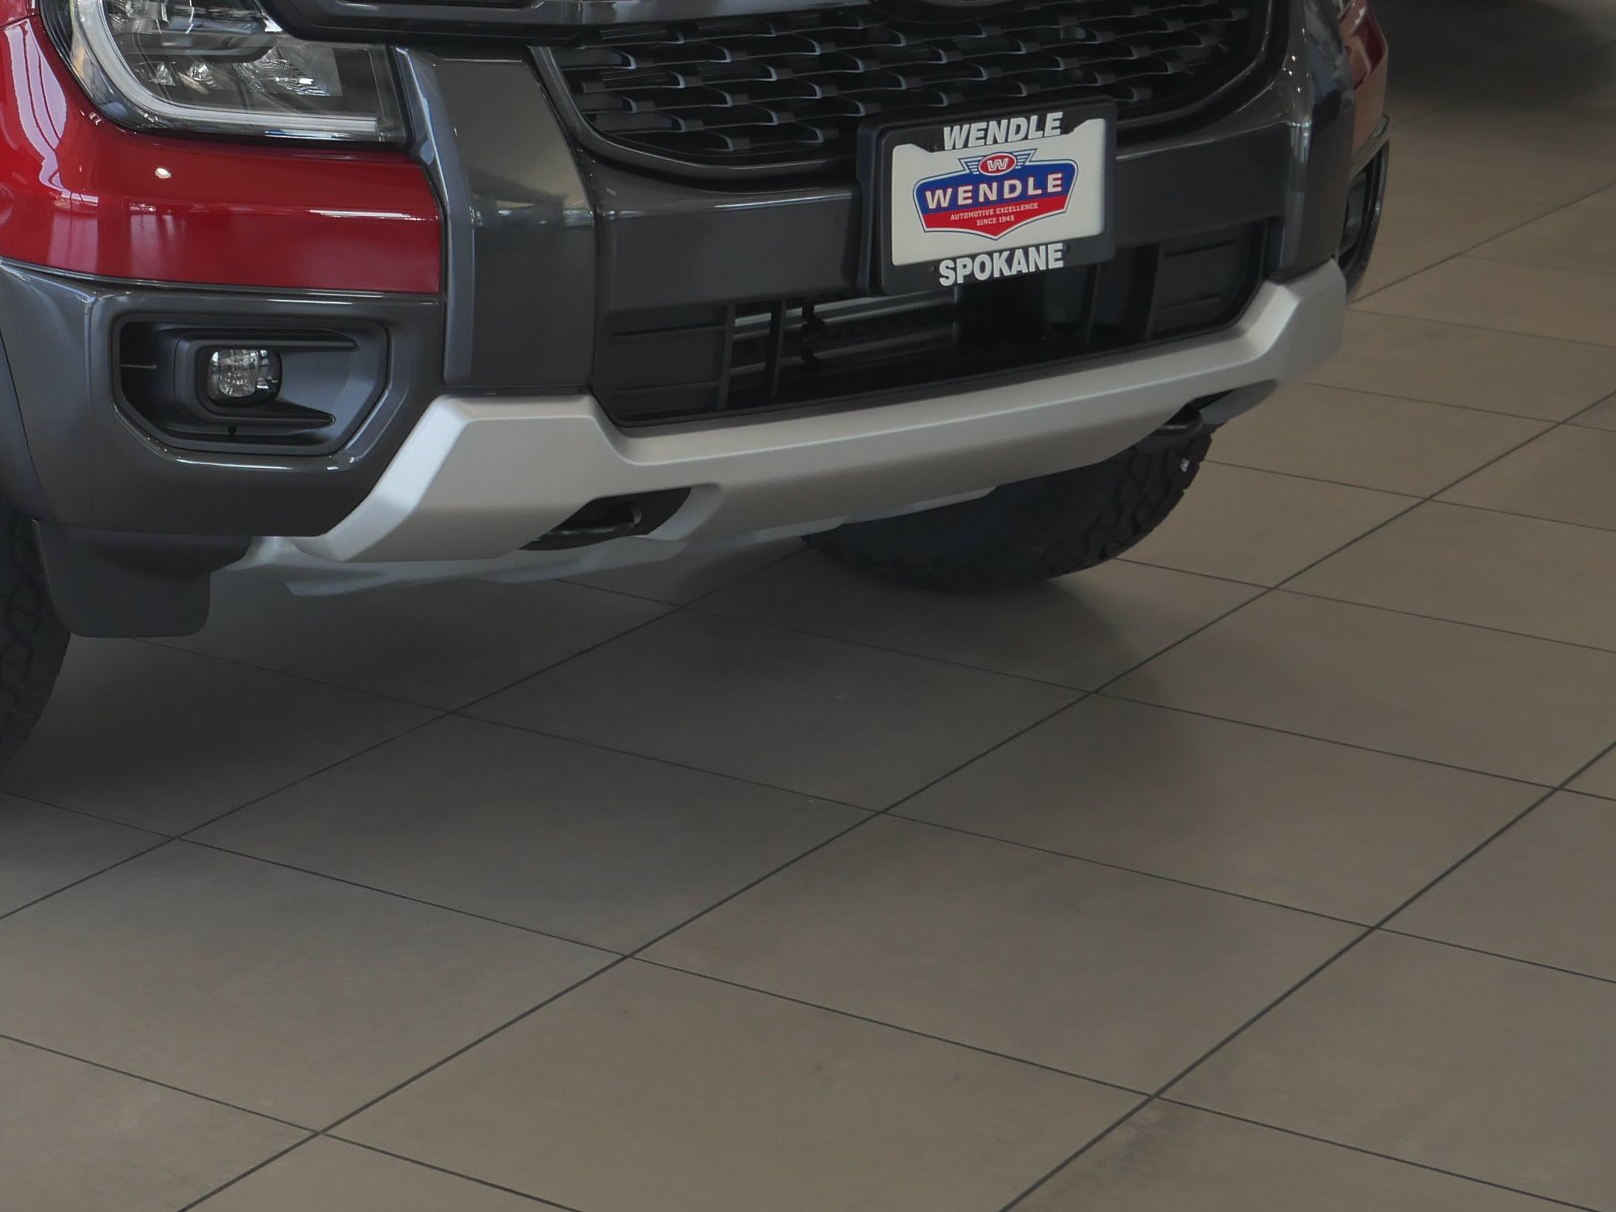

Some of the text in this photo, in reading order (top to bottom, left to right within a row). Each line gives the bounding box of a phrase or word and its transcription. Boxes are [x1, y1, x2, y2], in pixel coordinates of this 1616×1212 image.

[943, 112, 1065, 151] WENDLE
[986, 157, 1009, 172] W
[925, 173, 1063, 210] WENDLE
[950, 202, 1039, 221] AUTOMOTIVE EXCELLENCE
[976, 215, 1015, 226] SINCE 1943
[939, 242, 1064, 286] SPOKANE
